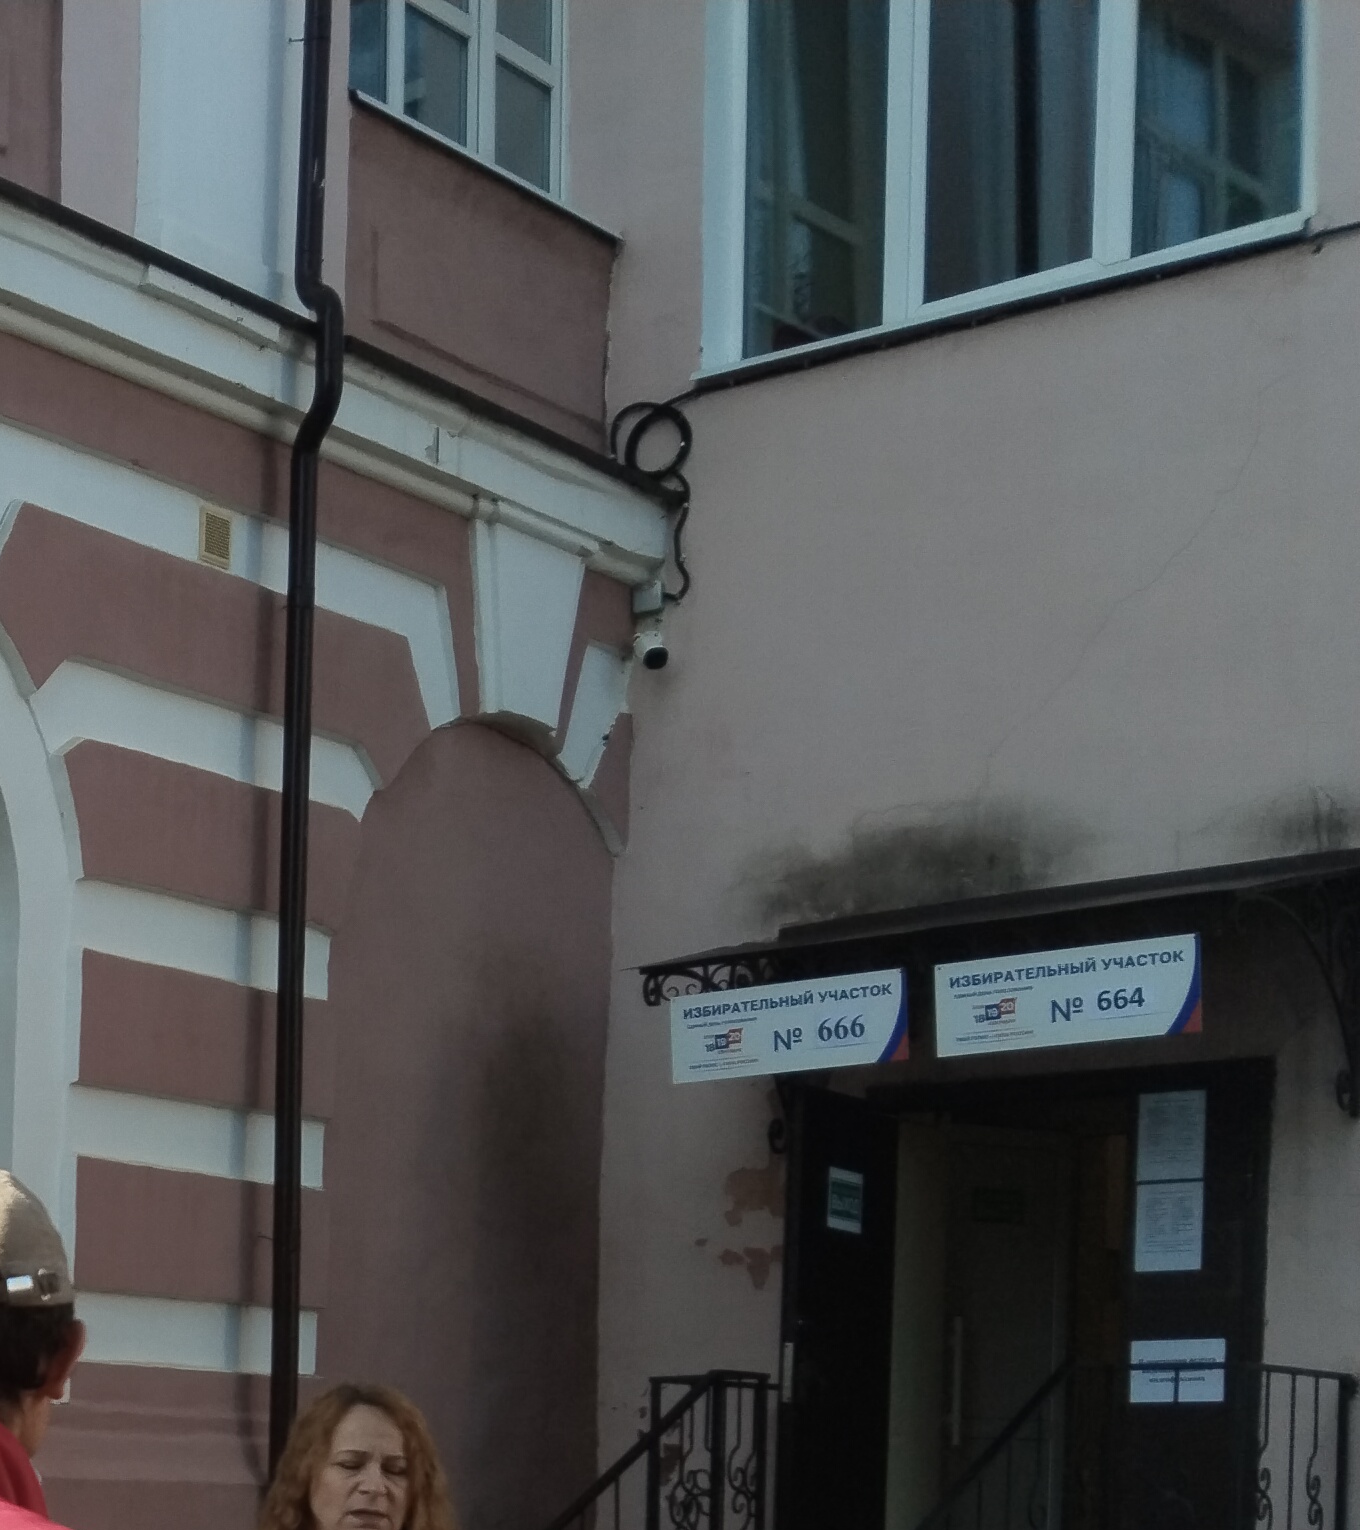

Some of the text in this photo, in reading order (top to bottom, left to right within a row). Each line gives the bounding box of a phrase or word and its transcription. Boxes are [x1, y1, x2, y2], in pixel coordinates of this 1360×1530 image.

[949, 949, 1185, 989] ИЗБИРАТЕЛЬНЫЙ УЧАСТОК
[682, 982, 893, 1020] ИЗБИРАТЕЛЬНЫЙ УЧАСТОК
[1050, 986, 1145, 1024] № 664
[773, 1014, 866, 1052] № 666
